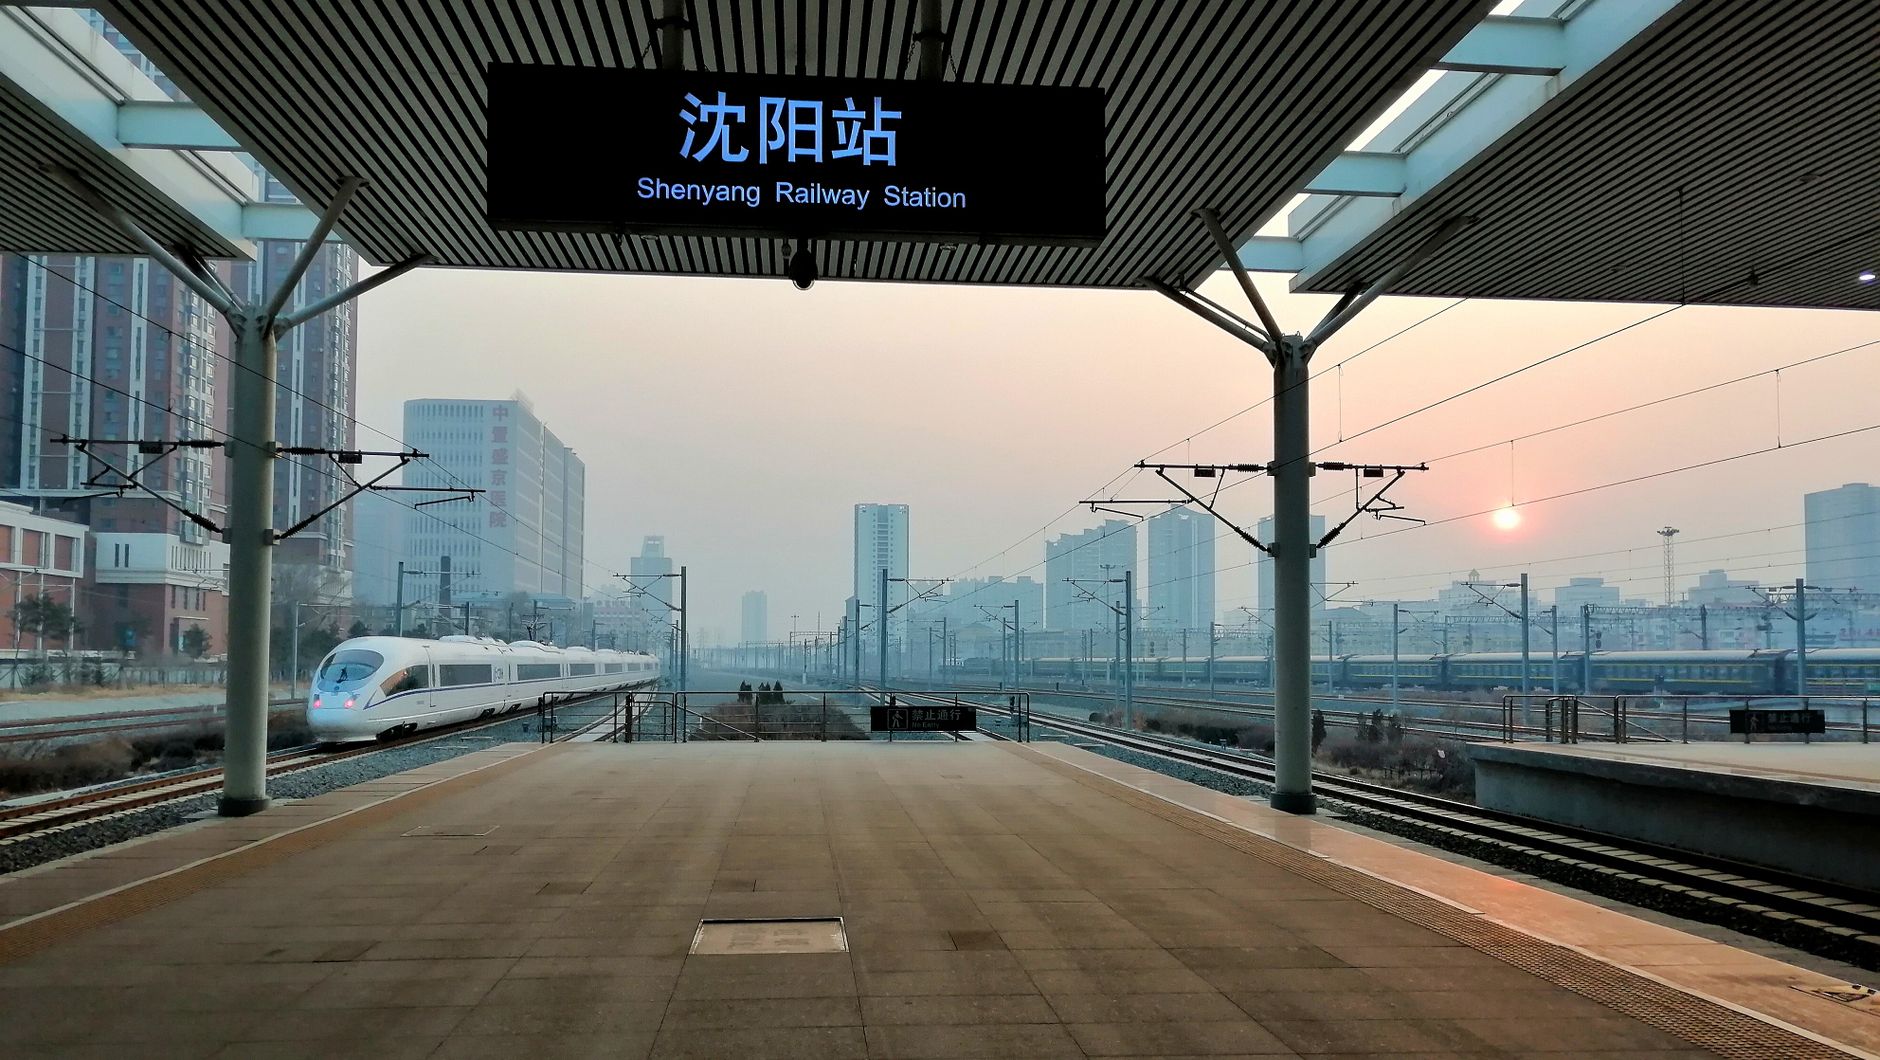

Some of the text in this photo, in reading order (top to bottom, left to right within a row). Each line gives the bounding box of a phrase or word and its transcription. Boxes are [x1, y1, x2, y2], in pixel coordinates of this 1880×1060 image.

[678, 91, 903, 167] 沈阳站
[636, 176, 967, 211] Shenyang Railway Station
[911, 708, 961, 721] 禁止通行
